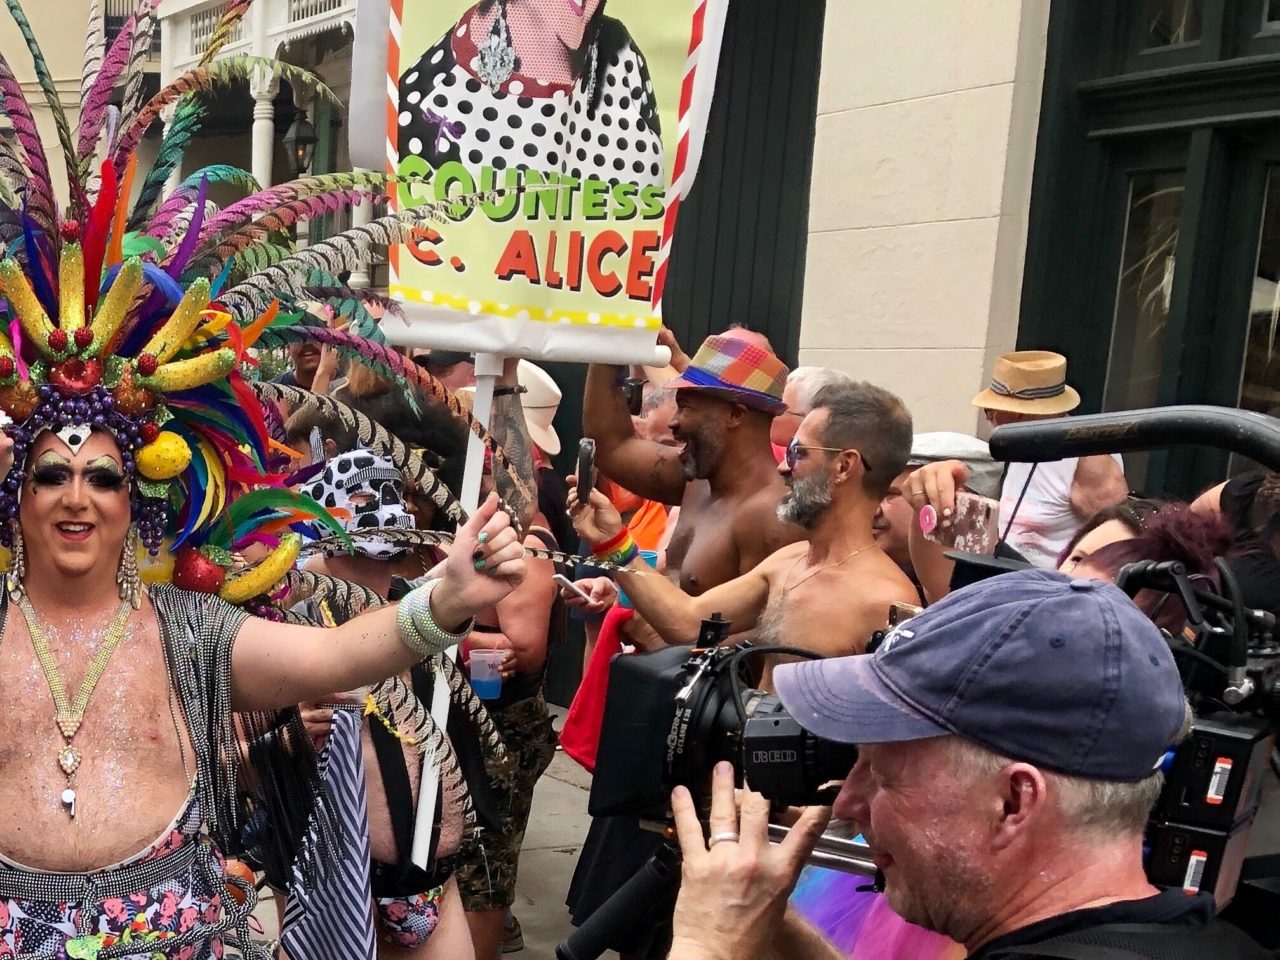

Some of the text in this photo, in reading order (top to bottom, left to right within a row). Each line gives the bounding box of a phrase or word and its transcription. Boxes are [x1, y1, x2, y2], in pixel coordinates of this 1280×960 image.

[398, 155, 666, 222] COUNTESS
[405, 227, 661, 302] C. ALICE
[753, 751, 797, 763] RED
